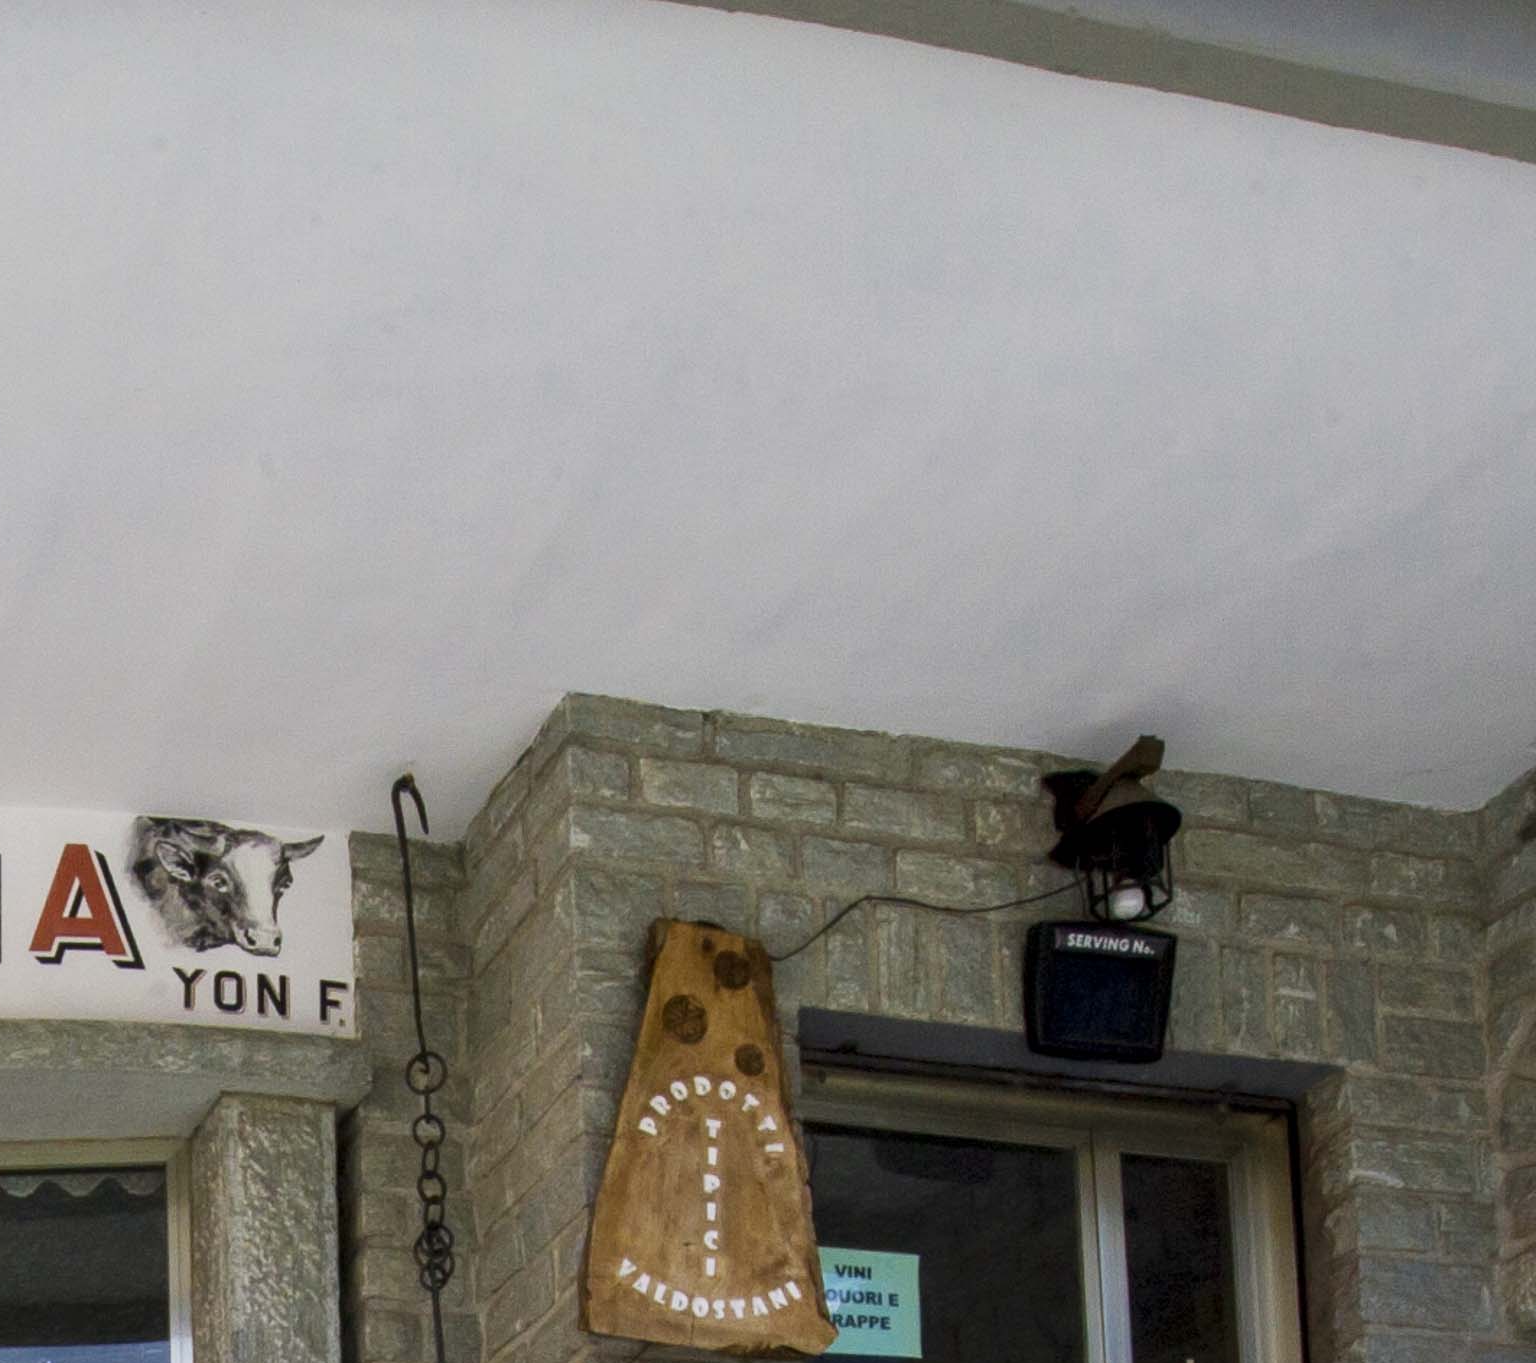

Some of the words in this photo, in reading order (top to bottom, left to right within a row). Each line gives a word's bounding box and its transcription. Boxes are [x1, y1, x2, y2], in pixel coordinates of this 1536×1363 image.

[1066, 932, 1130, 953] SERVING
[1132, 939, 1156, 956] No.
[172, 966, 290, 1020] YON
[638, 1075, 785, 1153] PRODOTTI
[703, 1117, 723, 1277] TIPICI
[618, 1257, 802, 1320] VALDOSTANI
[834, 1263, 872, 1280] VINI
[888, 1293, 900, 1308] E
[831, 1313, 892, 1331] RAPPE
